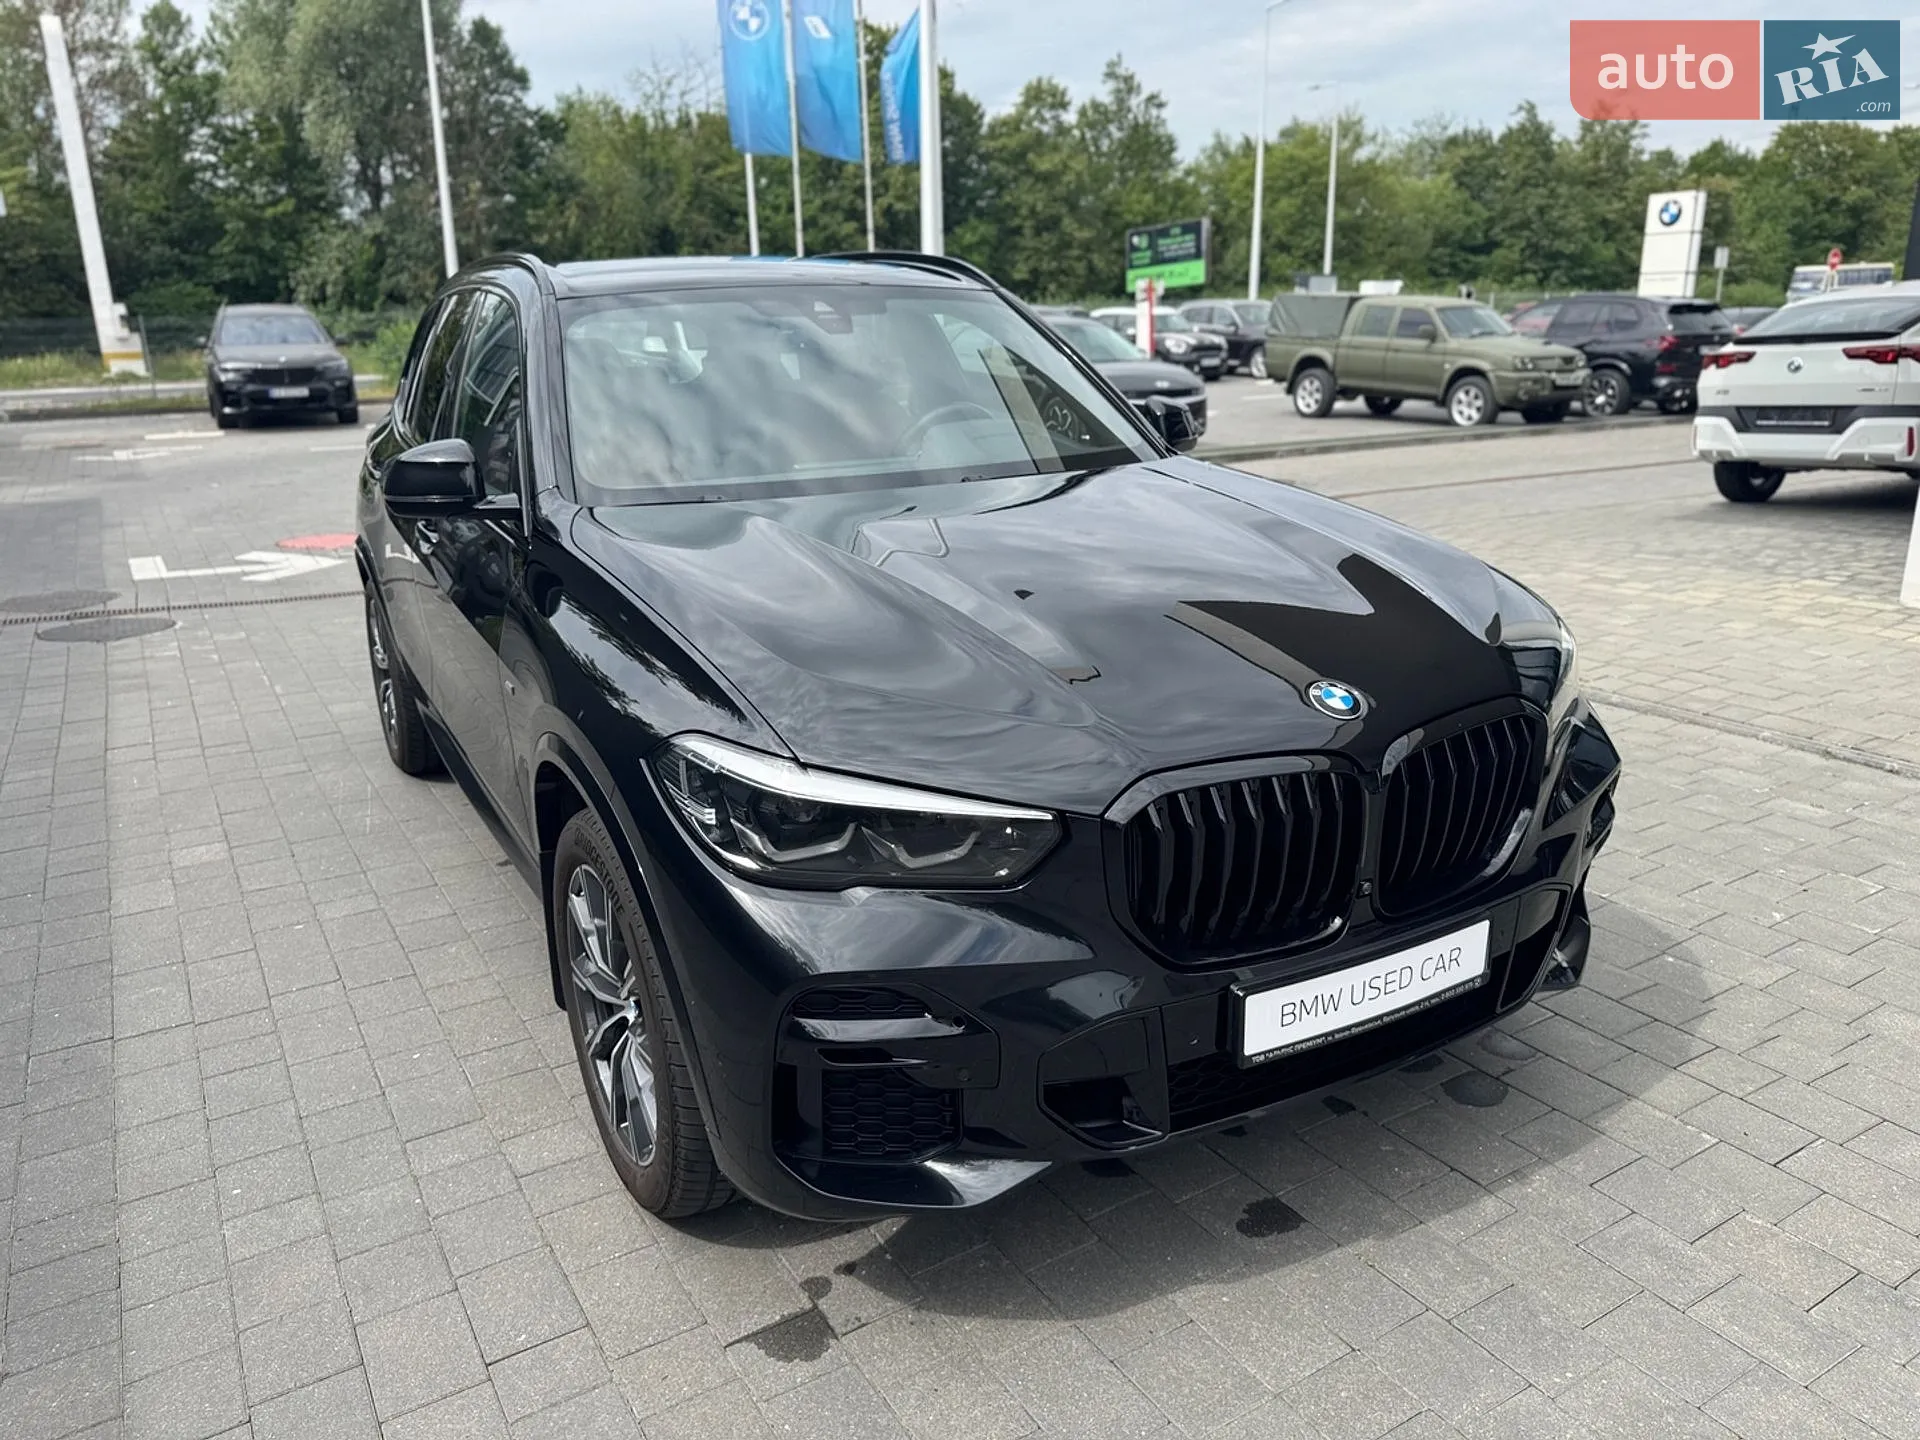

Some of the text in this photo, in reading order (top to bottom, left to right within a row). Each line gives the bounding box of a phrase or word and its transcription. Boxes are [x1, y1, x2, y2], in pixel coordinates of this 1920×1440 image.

[1280, 987, 1343, 1028] BMW
[1350, 965, 1414, 1007] USED
[1420, 947, 1462, 982] CAR
